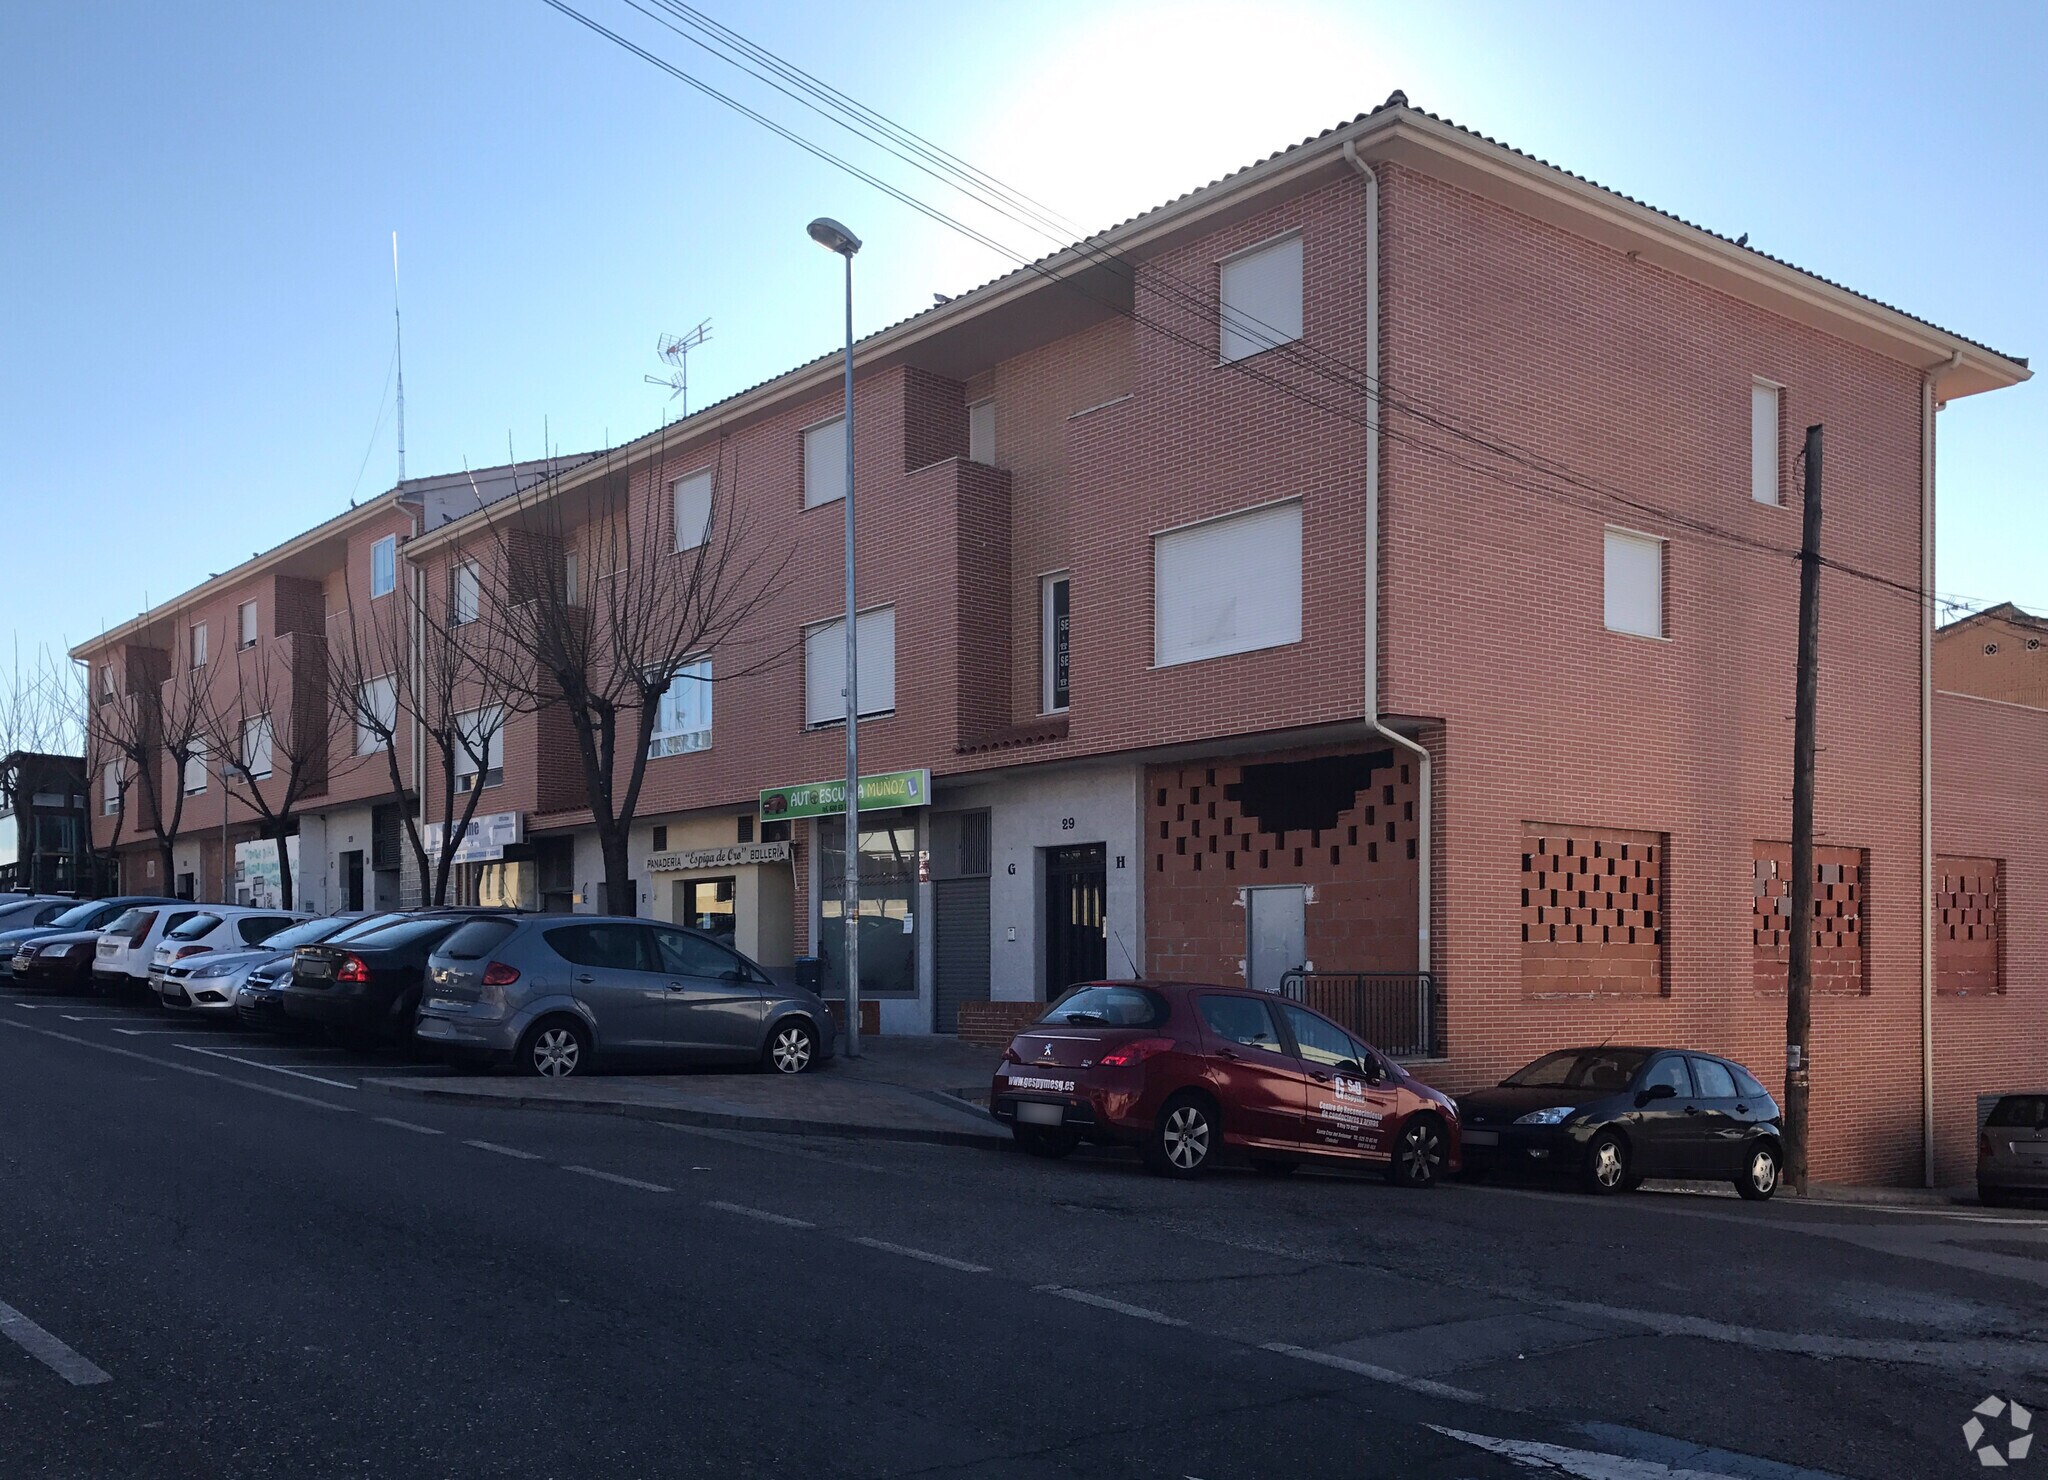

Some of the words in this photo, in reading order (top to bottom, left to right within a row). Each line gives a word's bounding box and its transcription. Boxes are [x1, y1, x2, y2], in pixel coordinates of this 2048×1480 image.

[790, 785, 864, 807] AUTOESCUA
[867, 777, 906, 798] MUÑOZ
[1062, 817, 1075, 830] 29
[716, 849, 726, 862] de
[750, 844, 785, 860] BOLLERÍA
[1008, 863, 1016, 875] G
[1116, 856, 1126, 869] H
[642, 893, 647, 903] F
